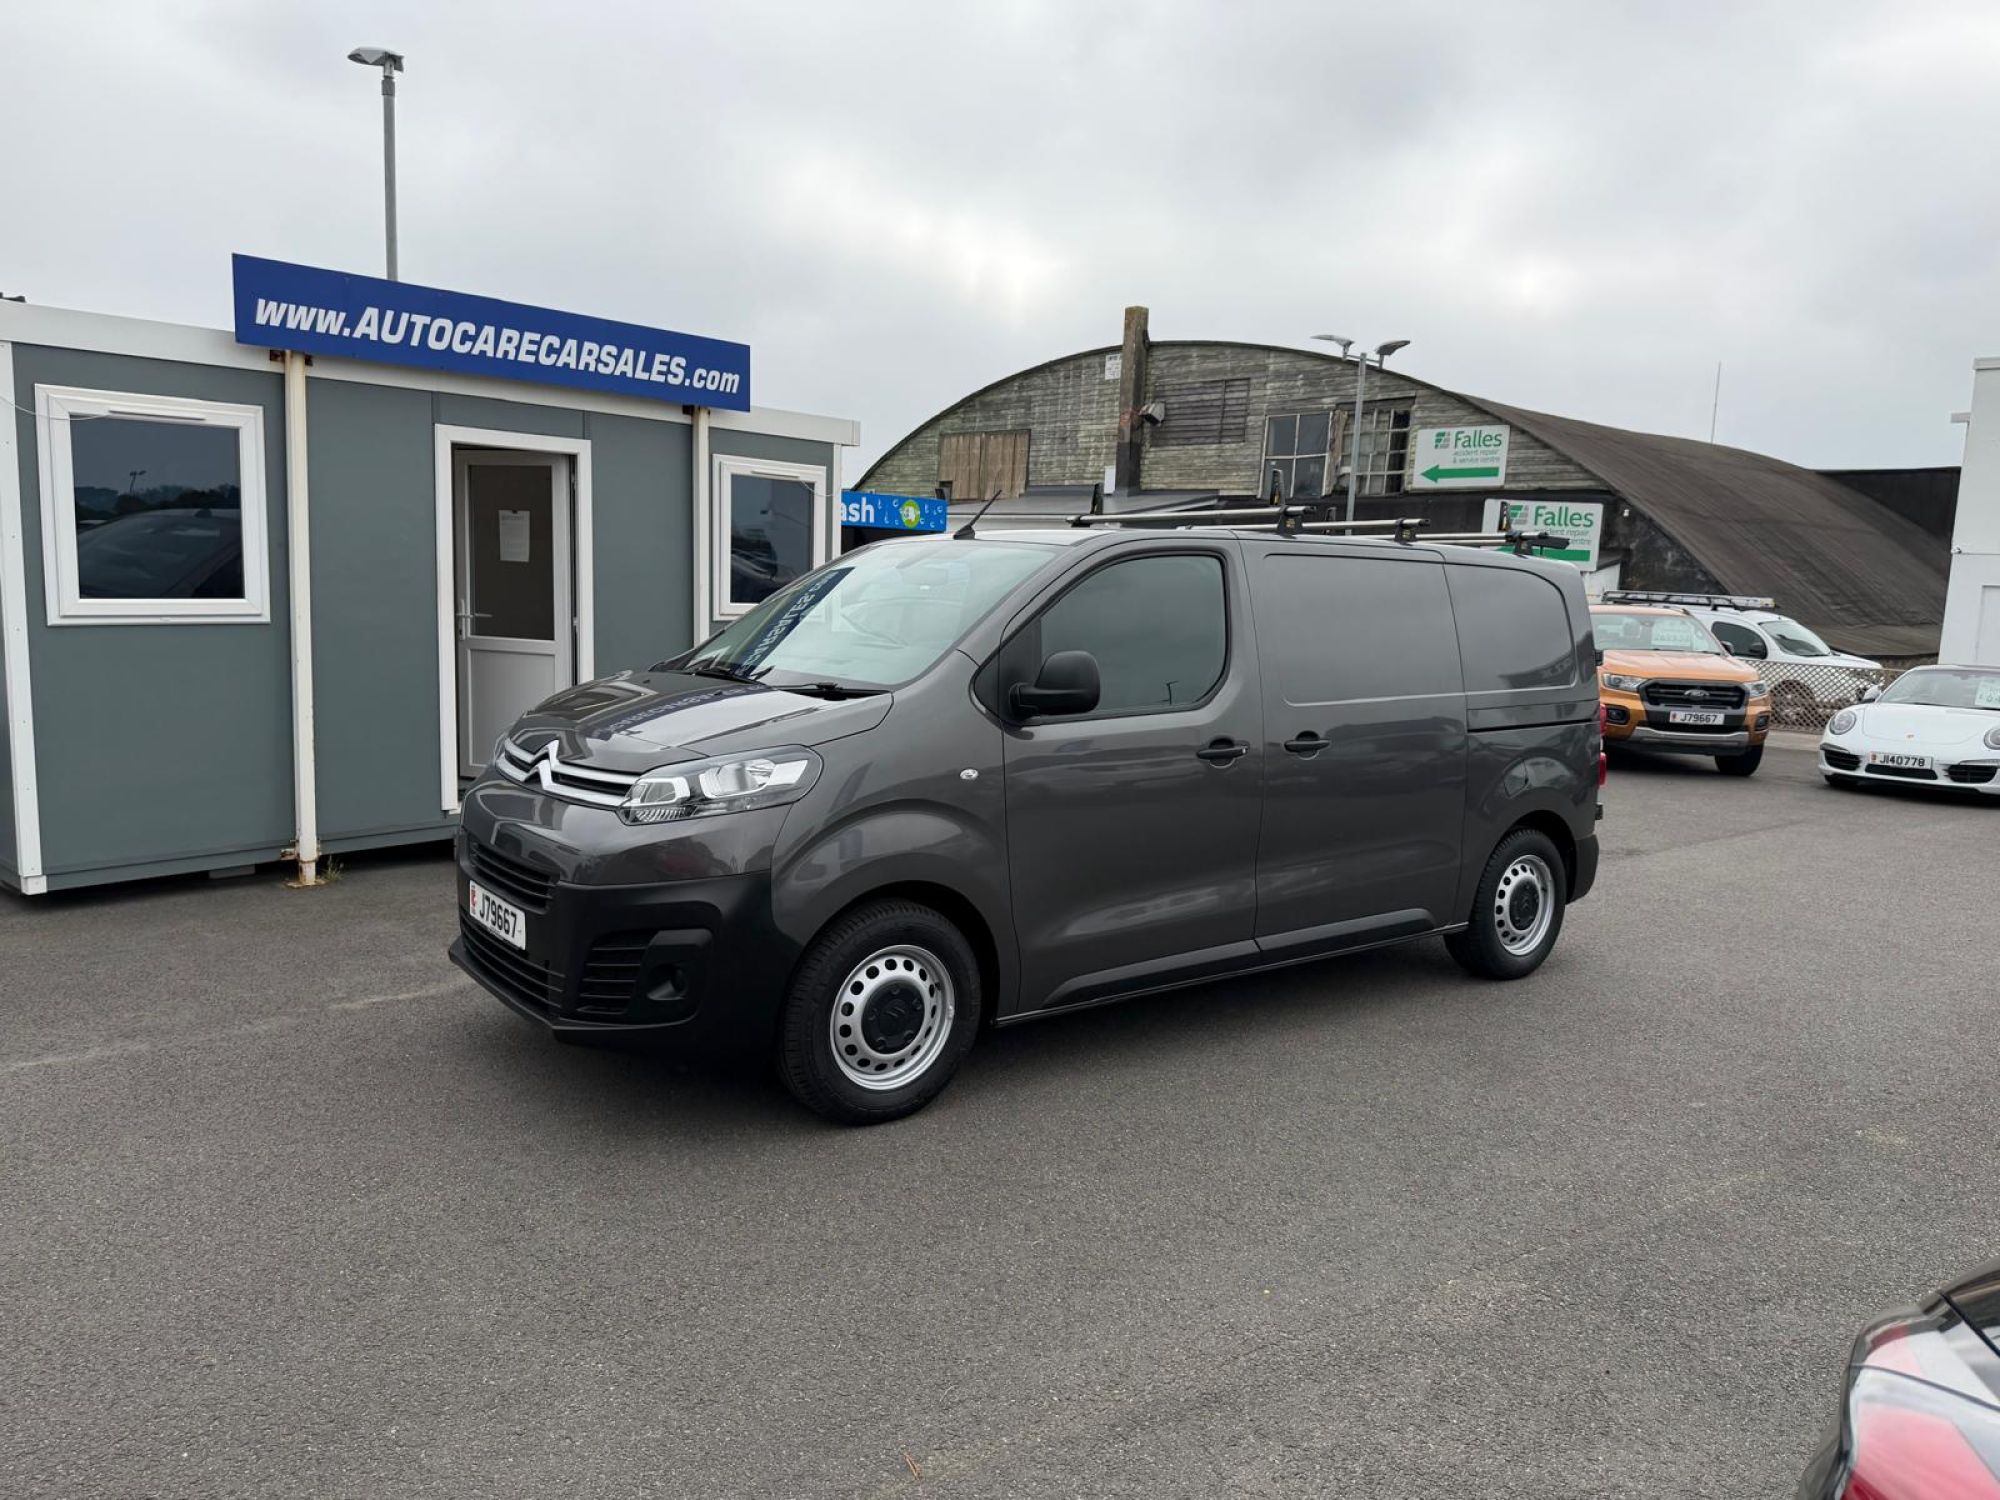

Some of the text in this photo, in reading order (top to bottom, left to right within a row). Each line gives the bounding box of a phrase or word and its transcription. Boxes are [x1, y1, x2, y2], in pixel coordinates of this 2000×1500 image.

[254, 297, 740, 394] www.AUTOCARECARSALES.com
[1454, 430, 1502, 449] Falles
[1534, 505, 1594, 528] Falles
[1680, 713, 1718, 723] J79667
[479, 893, 517, 939] J79667
